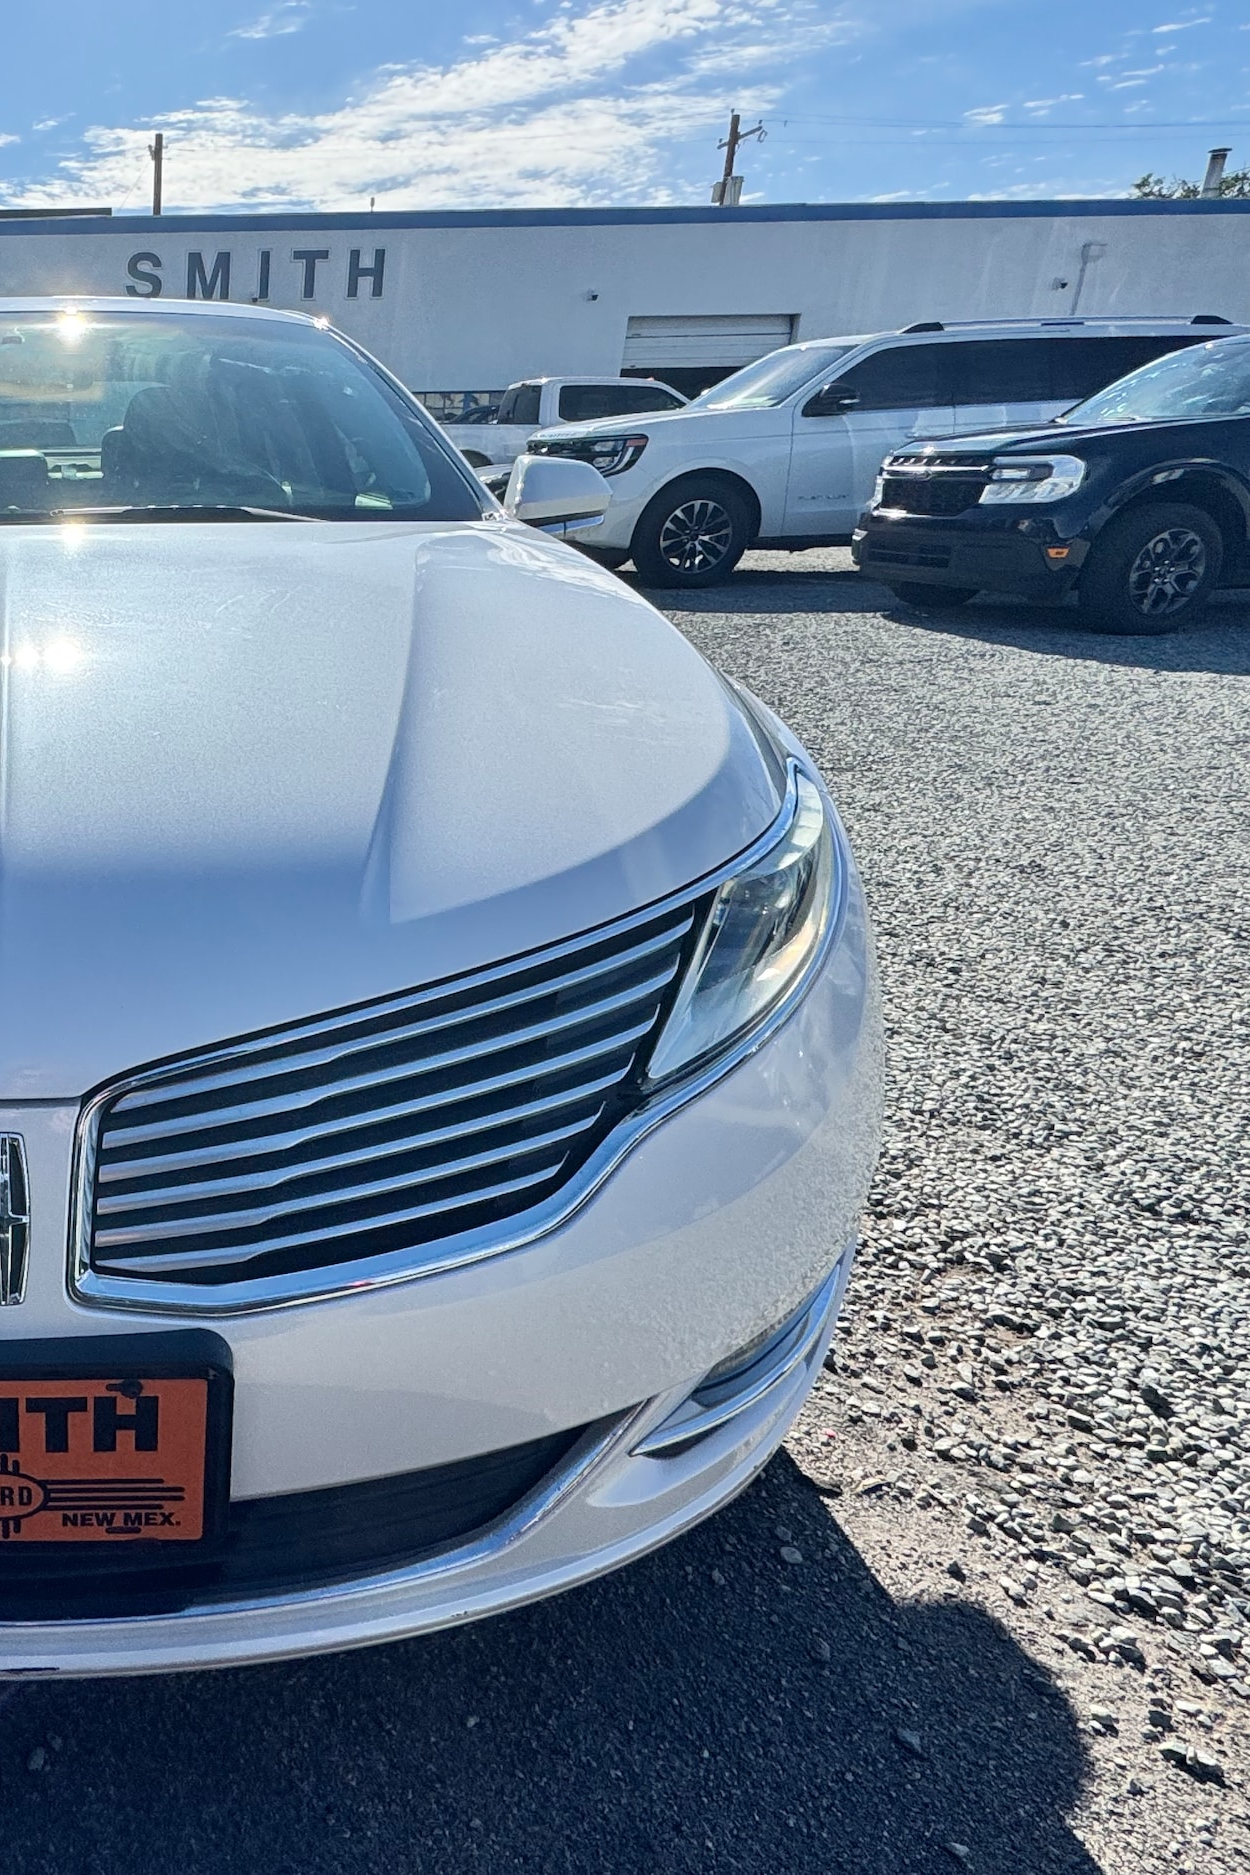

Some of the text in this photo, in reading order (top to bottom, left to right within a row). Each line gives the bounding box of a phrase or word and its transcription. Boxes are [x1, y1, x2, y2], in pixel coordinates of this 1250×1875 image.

[125, 248, 386, 299] SMITH
[62, 1512, 117, 1527] NEW
[123, 1512, 182, 1527] MEX.
